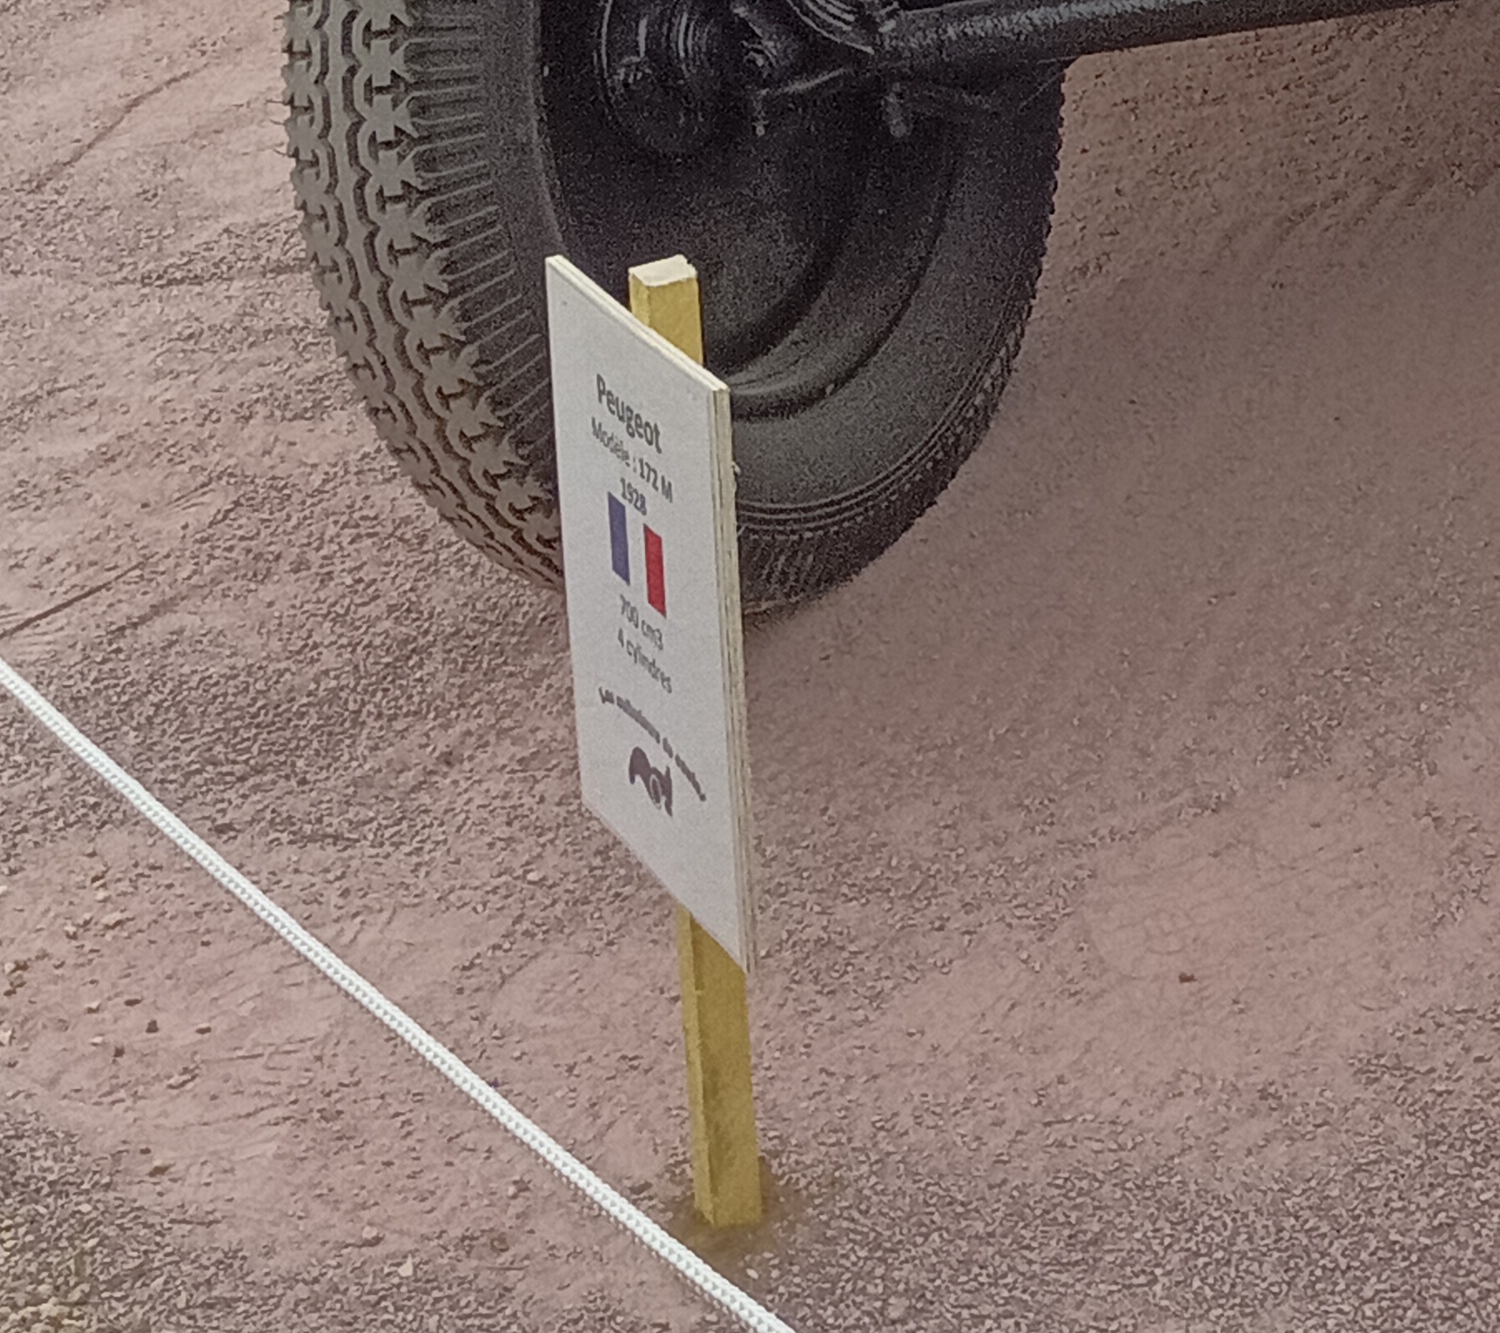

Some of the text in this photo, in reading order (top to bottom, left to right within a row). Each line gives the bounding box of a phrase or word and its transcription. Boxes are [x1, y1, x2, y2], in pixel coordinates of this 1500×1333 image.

[596, 373, 663, 455] Peugeot
[638, 457, 659, 492] 172
[660, 474, 673, 504] M
